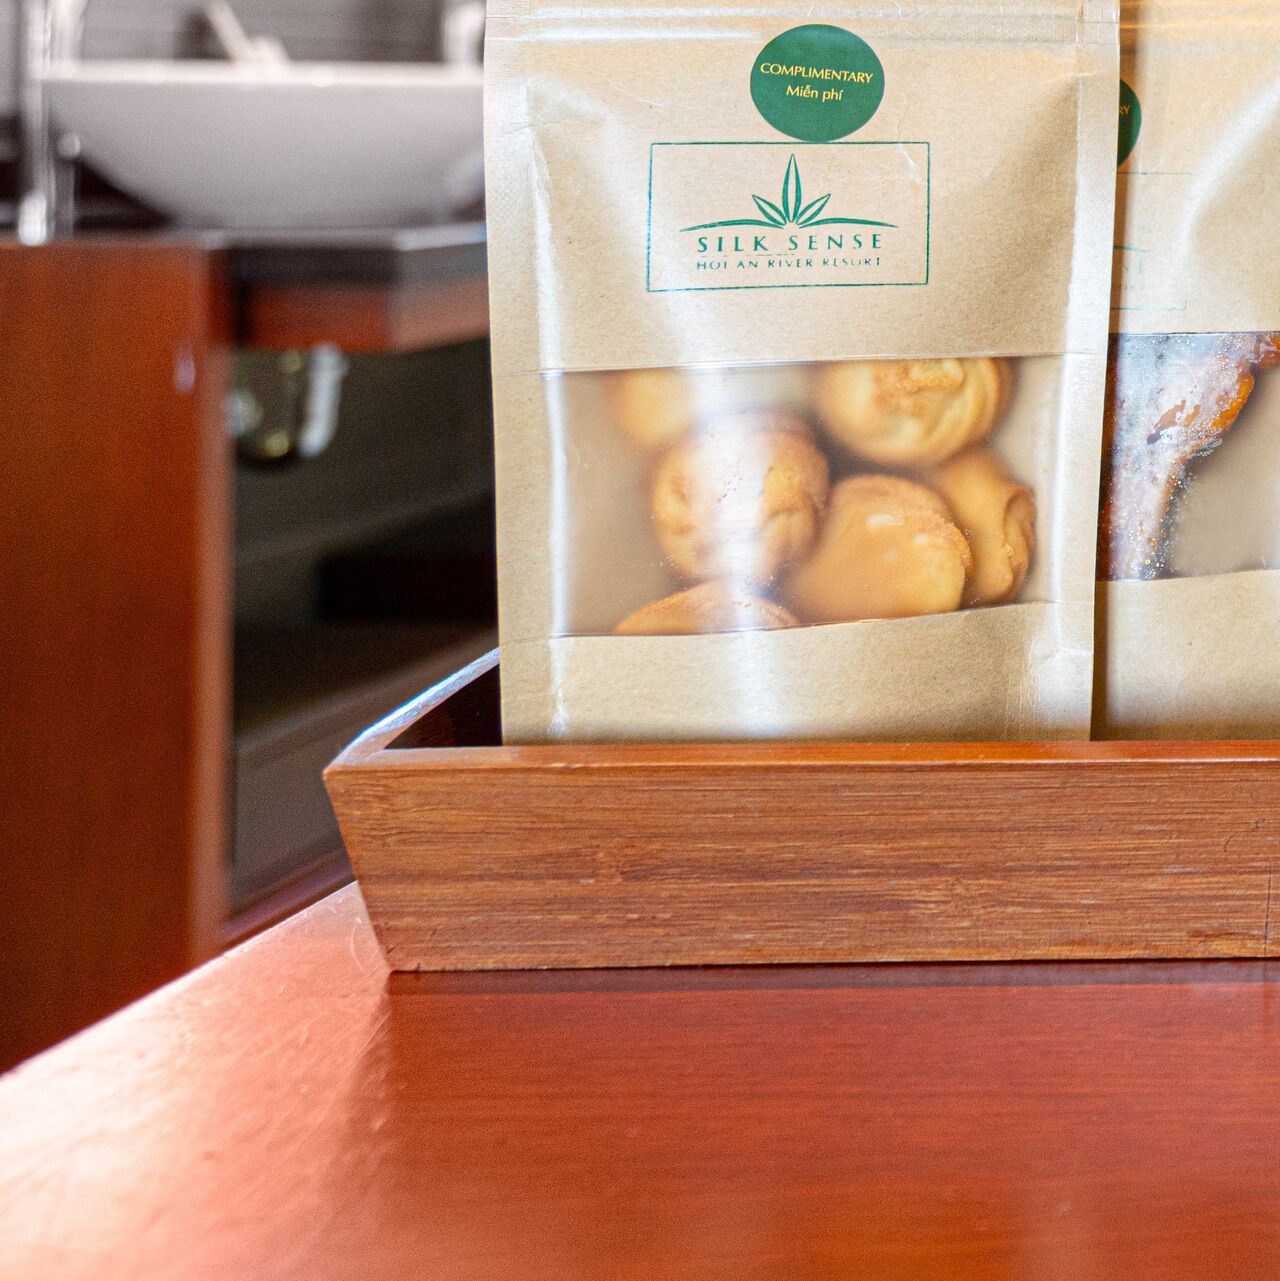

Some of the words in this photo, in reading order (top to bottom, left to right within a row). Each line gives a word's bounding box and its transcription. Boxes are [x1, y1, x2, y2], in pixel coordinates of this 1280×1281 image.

[760, 62, 874, 84] COMPLIMENTARY
[821, 88, 844, 103] phí
[697, 235, 768, 253] SILK
[788, 233, 882, 252] SENSE
[736, 260, 758, 270] AN
[768, 258, 813, 269] RIVER
